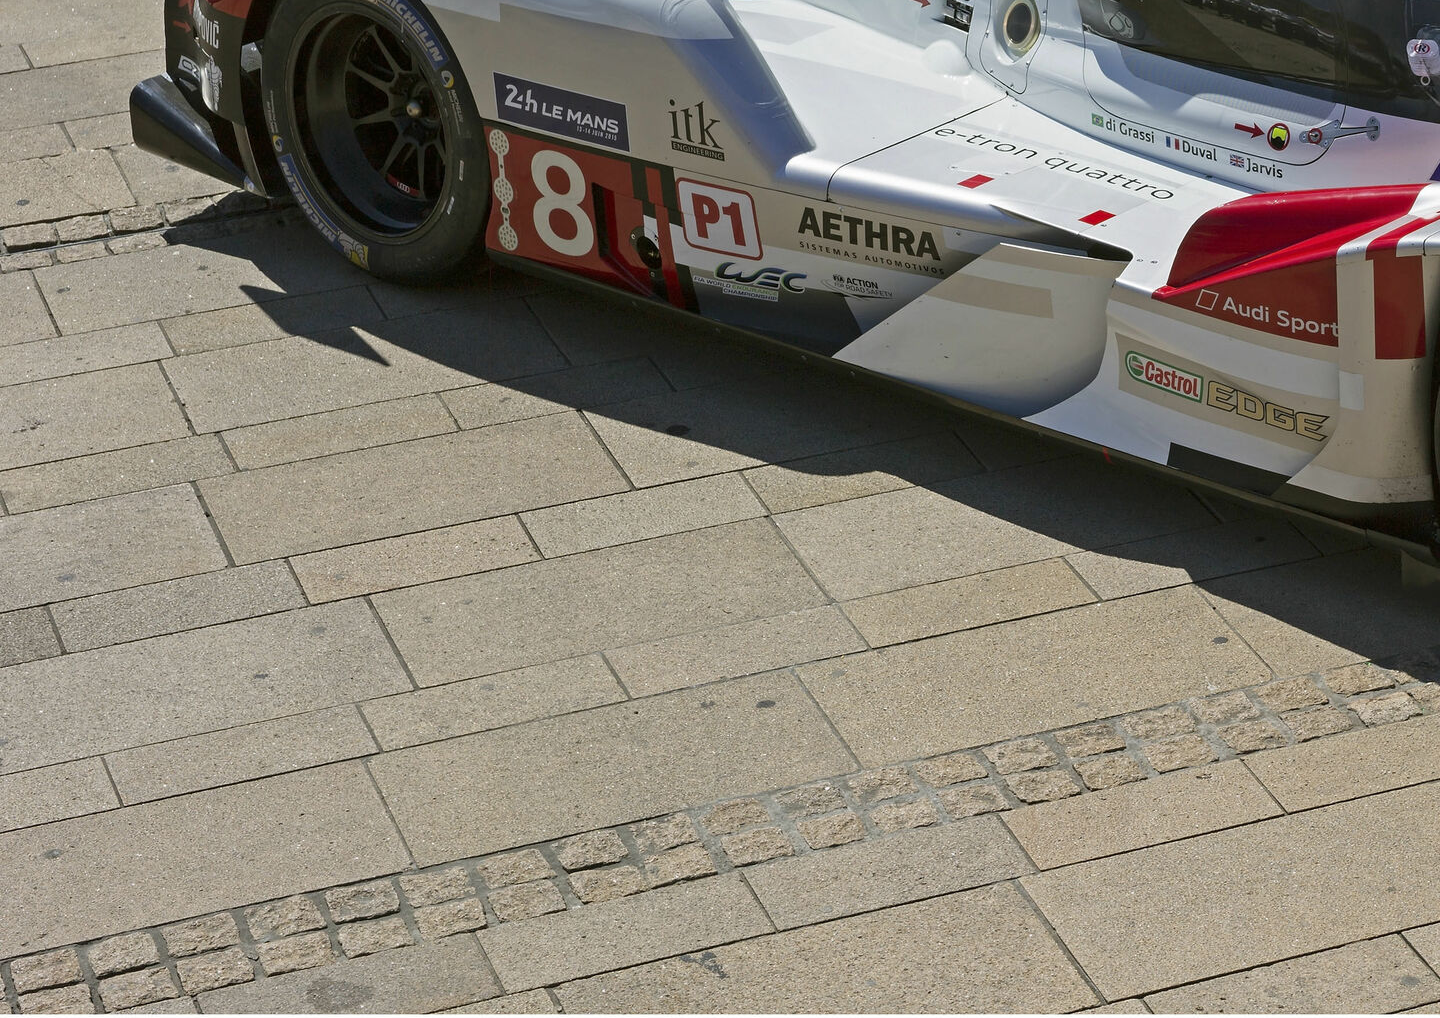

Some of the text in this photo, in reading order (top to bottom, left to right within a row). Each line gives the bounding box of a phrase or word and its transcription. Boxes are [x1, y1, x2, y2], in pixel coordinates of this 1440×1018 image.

[504, 84, 619, 133] 24h LE MANS
[668, 99, 724, 150] itk
[672, 141, 724, 161] ENGINEERING
[1106, 120, 1155, 144] di Grassi
[1182, 140, 1218, 162] Duval
[935, 123, 1175, 202] e-tron quattro
[1246, 157, 1284, 179] Jarvis
[281, 161, 337, 244] MICHELIN
[530, 149, 595, 258] 8
[691, 191, 748, 248] P1
[797, 206, 942, 262] AETHRA
[715, 262, 807, 293] WEC
[800, 241, 946, 277] SISTEMAS AUTOMOTIVOS
[705, 278, 731, 289] WORLD
[723, 288, 778, 302] CHAMPIONSHIP
[846, 277, 879, 289] ACTION
[1222, 296, 1339, 338] Audi Sport
[1144, 360, 1330, 441] Castrol EDGE
